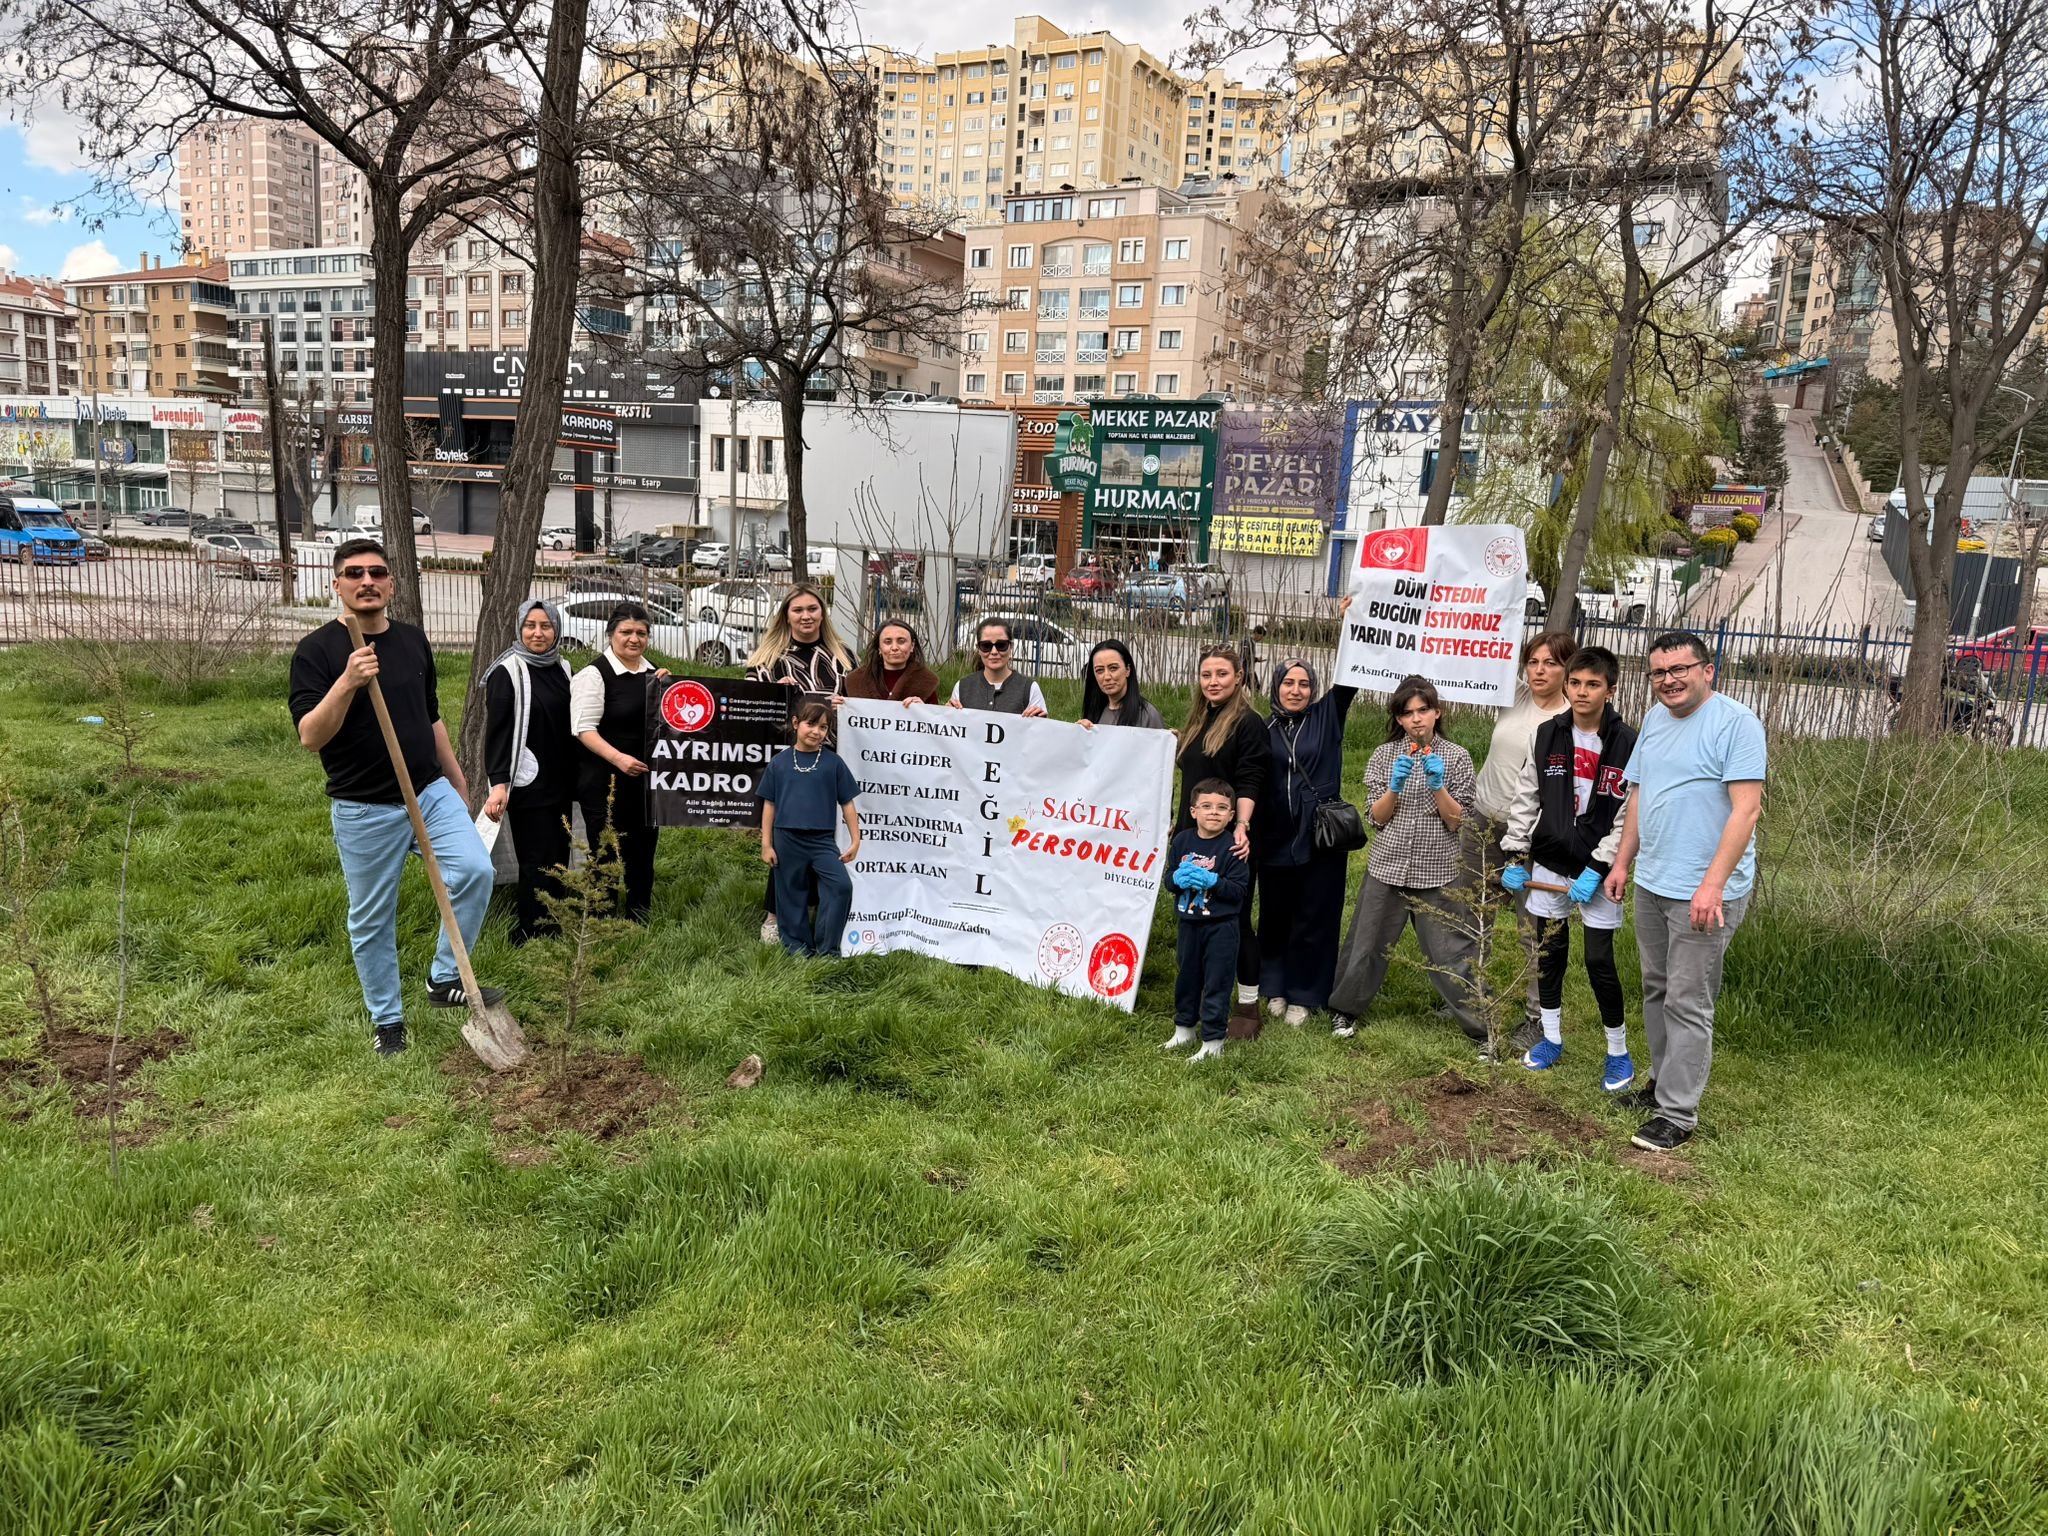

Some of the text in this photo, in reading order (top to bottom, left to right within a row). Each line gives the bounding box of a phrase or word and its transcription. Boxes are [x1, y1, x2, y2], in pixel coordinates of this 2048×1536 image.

[562, 414, 614, 433] KARADAŞ
[1091, 409, 1215, 429] MEKKE PAZARI
[435, 447, 469, 463] Bayteks
[475, 470, 494, 478] çocuk
[1059, 455, 1098, 477] HURMACI
[613, 476, 637, 486] Pijama
[641, 478, 661, 488] Eşarp
[1094, 488, 1201, 512] HURMACI
[1393, 576, 1488, 605] DÜN İSTEDİK
[1368, 601, 1502, 632] BUGÜN İSTİYORUZ
[1350, 624, 1513, 660] YARIN DA İSTEYECEĞİZ
[848, 715, 967, 739] GRUP ELEMANI
[860, 749, 953, 769] CARİ GİDER
[650, 770, 752, 794] KADRO
[1597, 765, 1626, 800] R
[914, 787, 960, 802] ALIMI
[1042, 797, 1132, 832] SAĞLIK
[859, 829, 948, 848] PERSONELİ
[1011, 828, 1159, 874] PERSONELİ
[855, 861, 948, 879] ORTAK ALAN
[1104, 872, 1155, 891] DİYECEĞİZ
